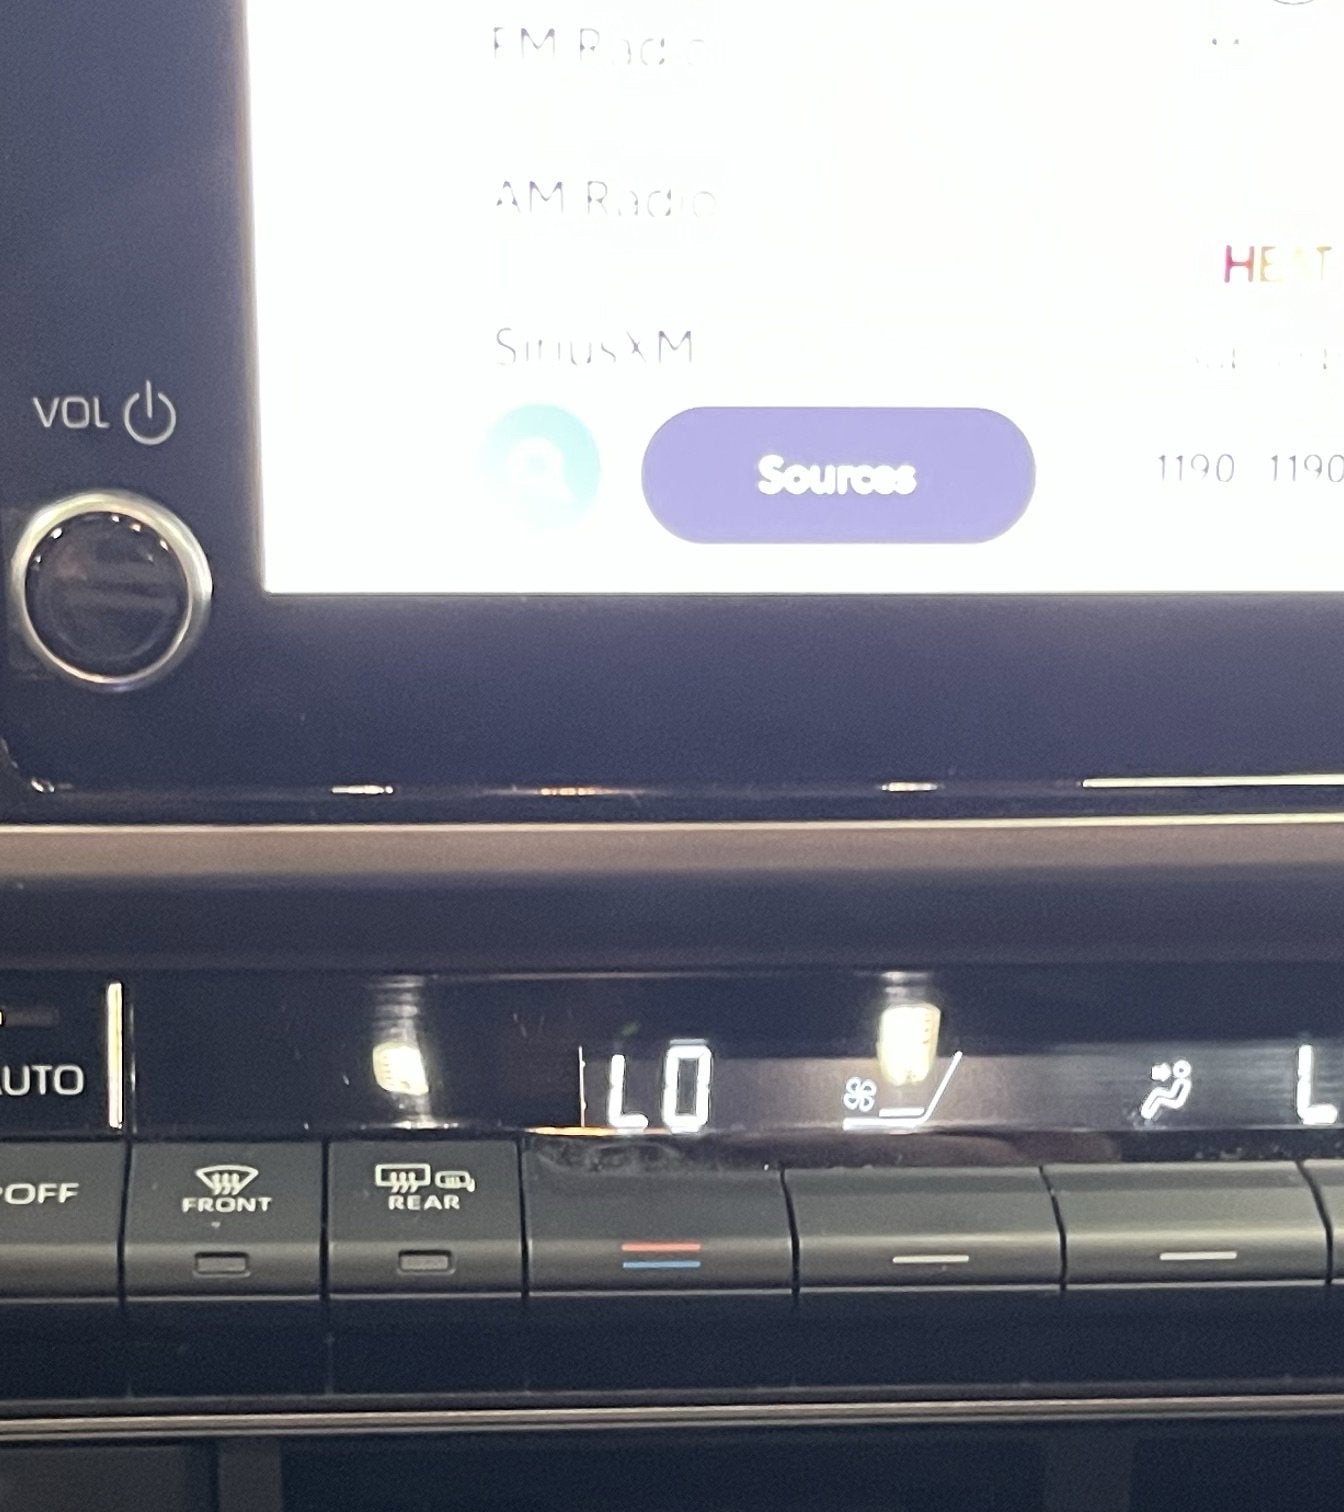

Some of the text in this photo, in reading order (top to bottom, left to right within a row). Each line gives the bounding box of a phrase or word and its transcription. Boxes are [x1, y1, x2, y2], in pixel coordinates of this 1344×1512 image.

[491, 25, 558, 62] FM
[495, 178, 565, 216] AM
[494, 325, 696, 368] SiriusXM
[32, 395, 111, 429] VOL
[757, 454, 918, 496] Sources
[1157, 452, 1237, 485] 1190
[608, 1037, 713, 1132] LO
[4, 1182, 80, 1206] OFF
[181, 1196, 273, 1214] FRONT
[387, 1193, 462, 1212] REAR
